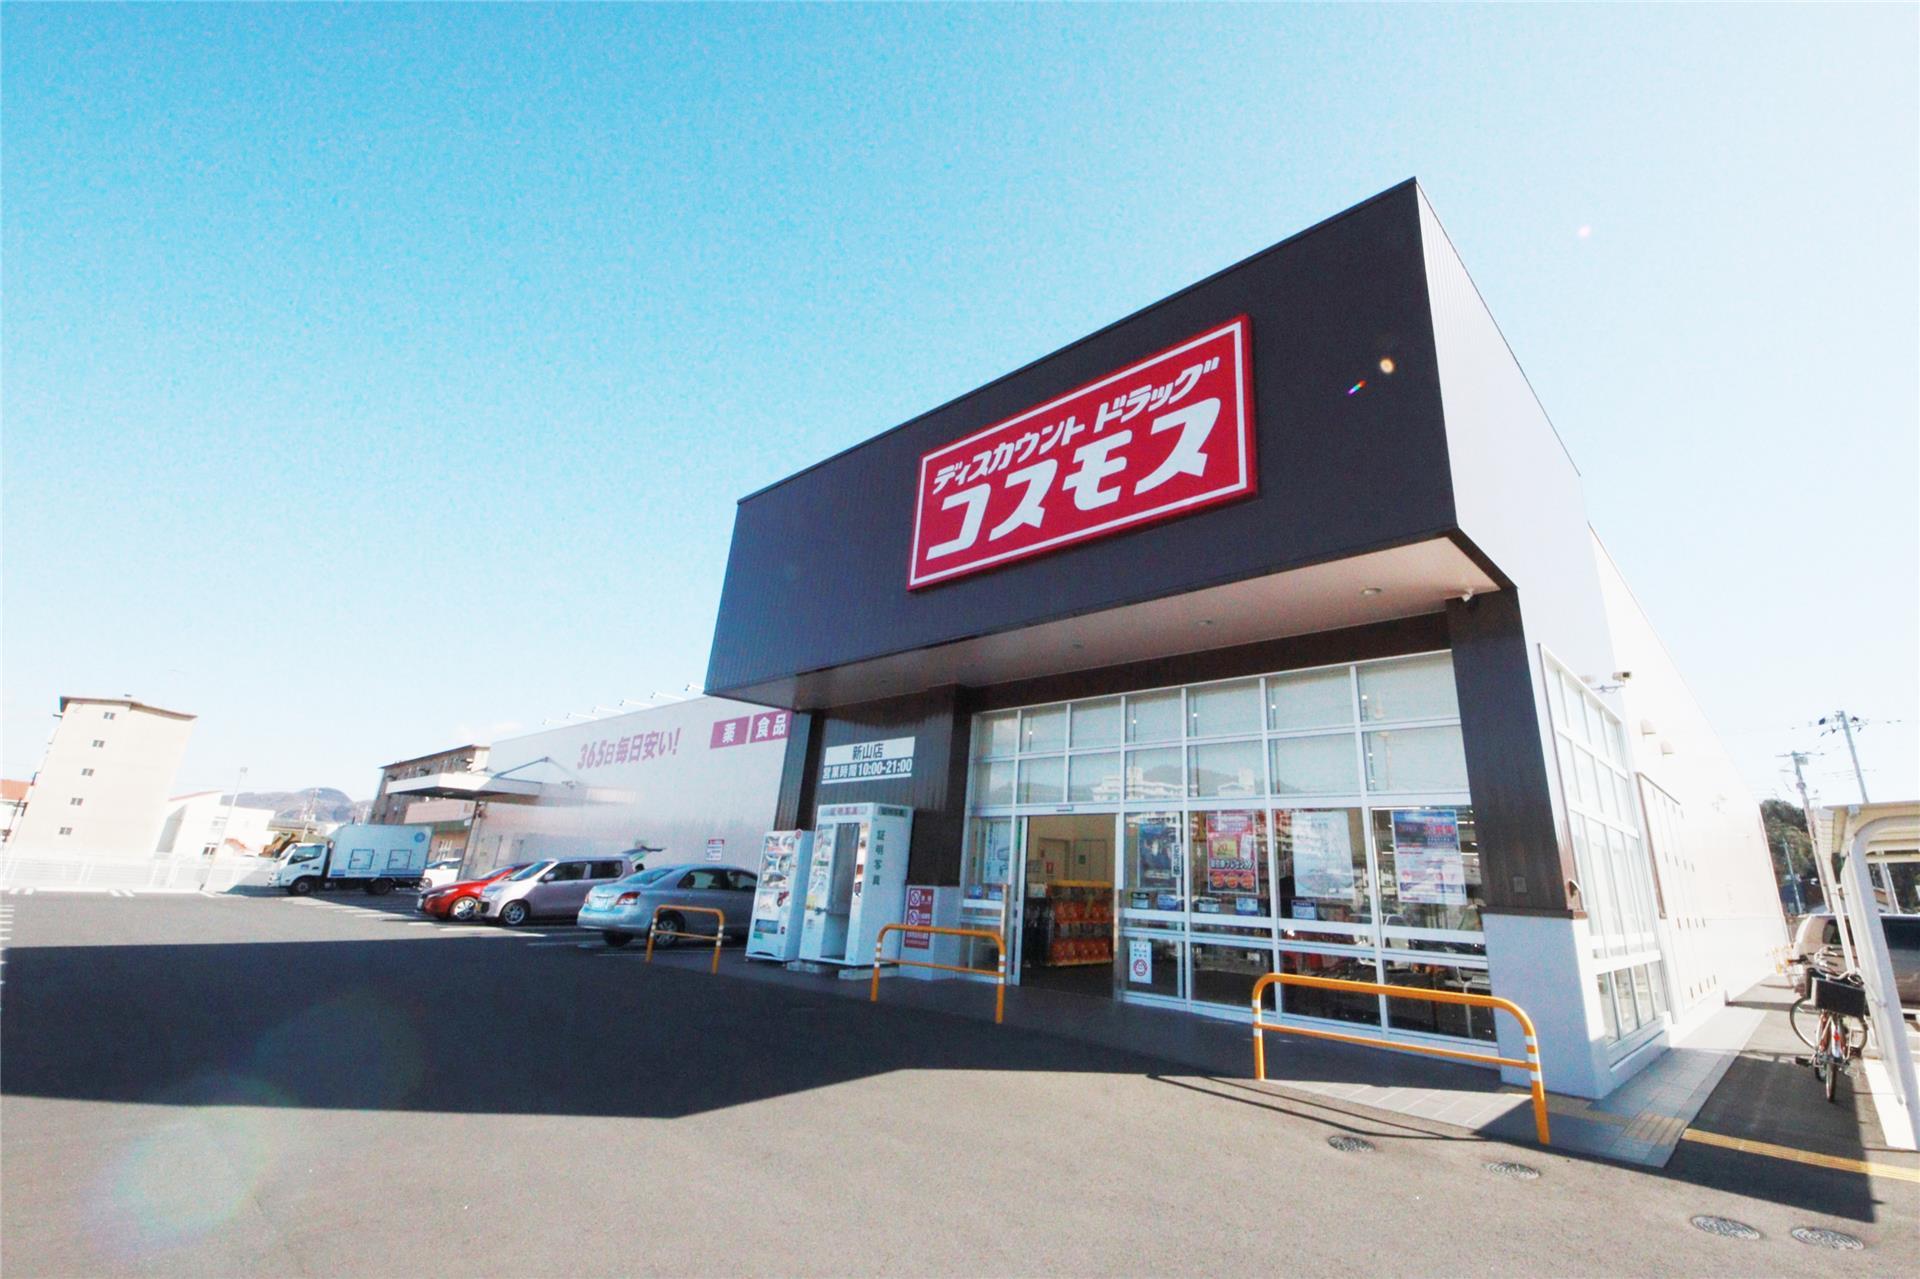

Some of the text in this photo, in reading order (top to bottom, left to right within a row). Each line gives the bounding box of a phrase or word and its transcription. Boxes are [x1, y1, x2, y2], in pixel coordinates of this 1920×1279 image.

[932, 357, 1220, 495] ディスカウント ドラッグ
[926, 397, 1221, 560] コスモス
[755, 713, 786, 739] 食品
[852, 743, 883, 760] 新山店
